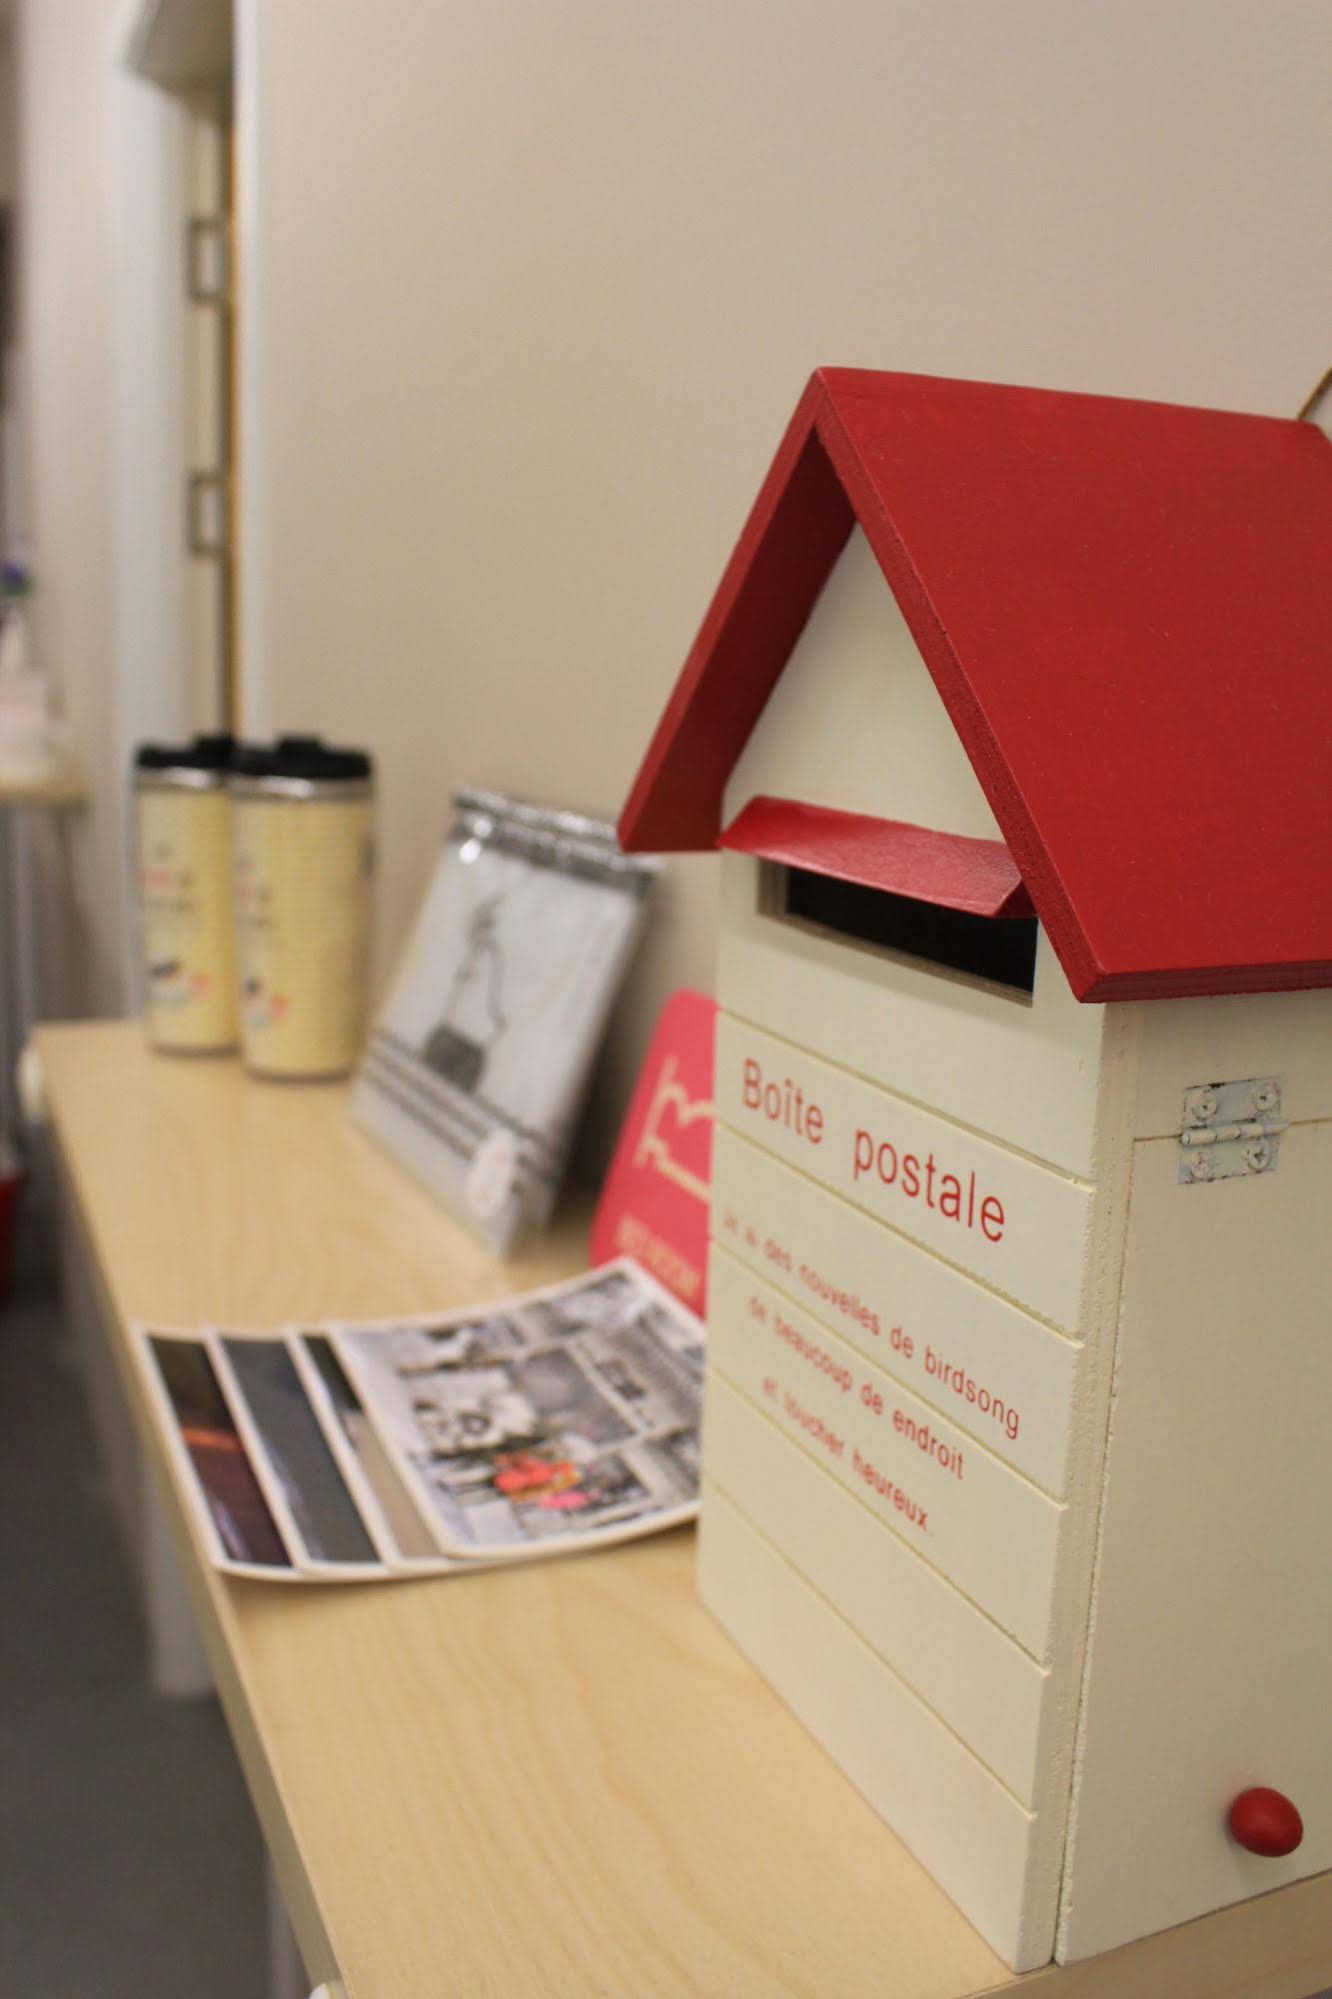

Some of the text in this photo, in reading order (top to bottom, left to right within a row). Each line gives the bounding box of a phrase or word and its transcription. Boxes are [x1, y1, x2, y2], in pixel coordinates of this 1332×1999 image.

[853, 1128, 1005, 1243] postale
[799, 1263, 880, 1336] nouvelles
[887, 1324, 914, 1359] de
[924, 1346, 1019, 1440] birdsong
[860, 1382, 883, 1416] de
[892, 1408, 964, 1480] endroit
